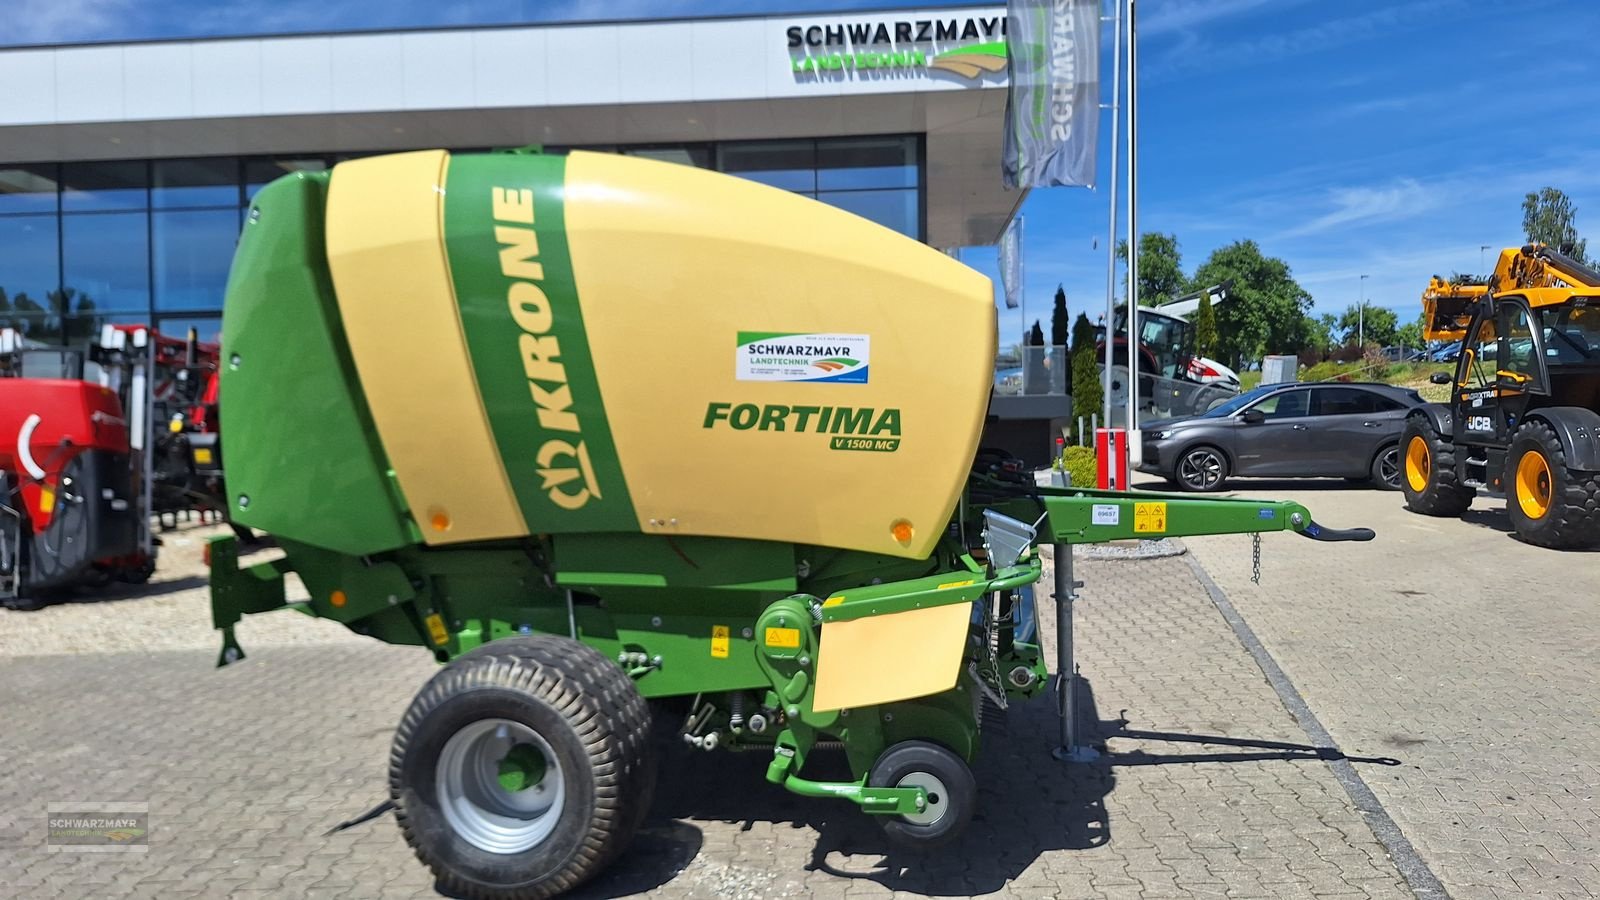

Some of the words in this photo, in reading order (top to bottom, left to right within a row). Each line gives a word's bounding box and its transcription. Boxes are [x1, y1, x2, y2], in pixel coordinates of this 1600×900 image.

[791, 50, 926, 73] LANDTECHNIK
[492, 186, 581, 433] KRONE
[748, 344, 851, 357] SCHWARZMAYR
[750, 357, 809, 366] LANDTECHNIK
[703, 402, 901, 436] FORTIMA
[1468, 415, 1491, 430] JCB
[835, 438, 843, 448] V
[847, 438, 872, 449] 1500
[875, 439, 894, 450] MC
